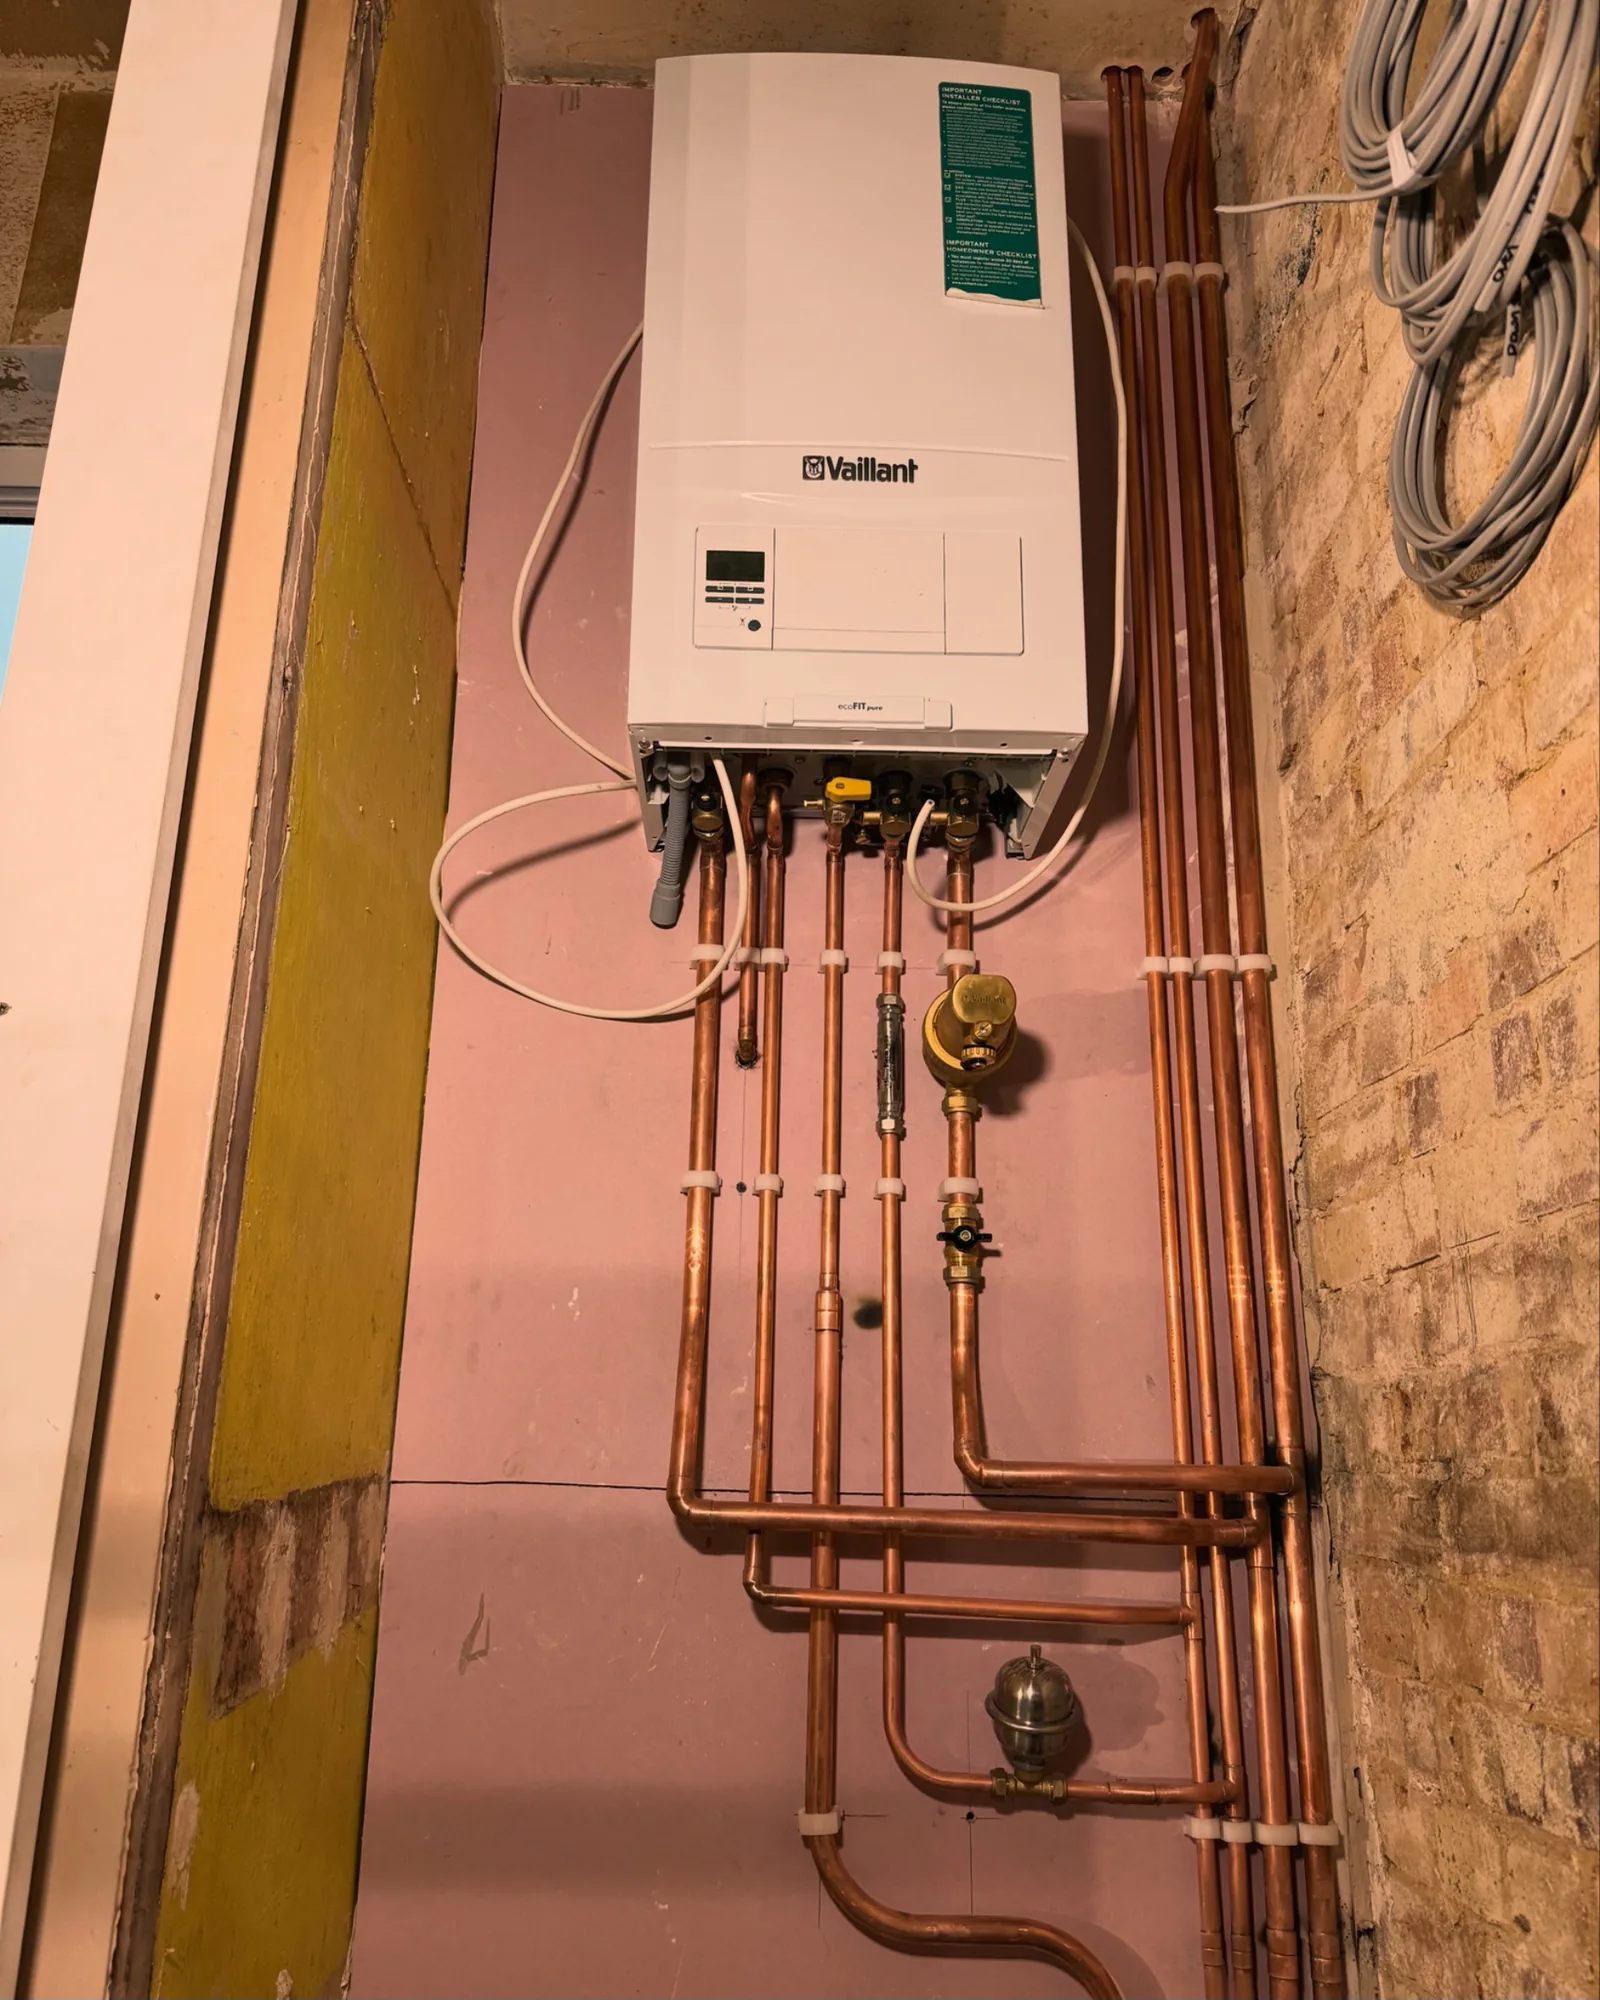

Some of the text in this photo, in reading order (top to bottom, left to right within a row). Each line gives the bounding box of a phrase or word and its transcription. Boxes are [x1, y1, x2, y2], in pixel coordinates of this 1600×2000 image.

[941, 87, 982, 95] IMPORTANT
[941, 93, 1021, 105] INSTALLER CHECKLIST
[946, 239, 989, 248] IMPORTANT
[946, 247, 1037, 259] HOMEOWNER CHECKLIST
[826, 456, 919, 483] Vaillant
